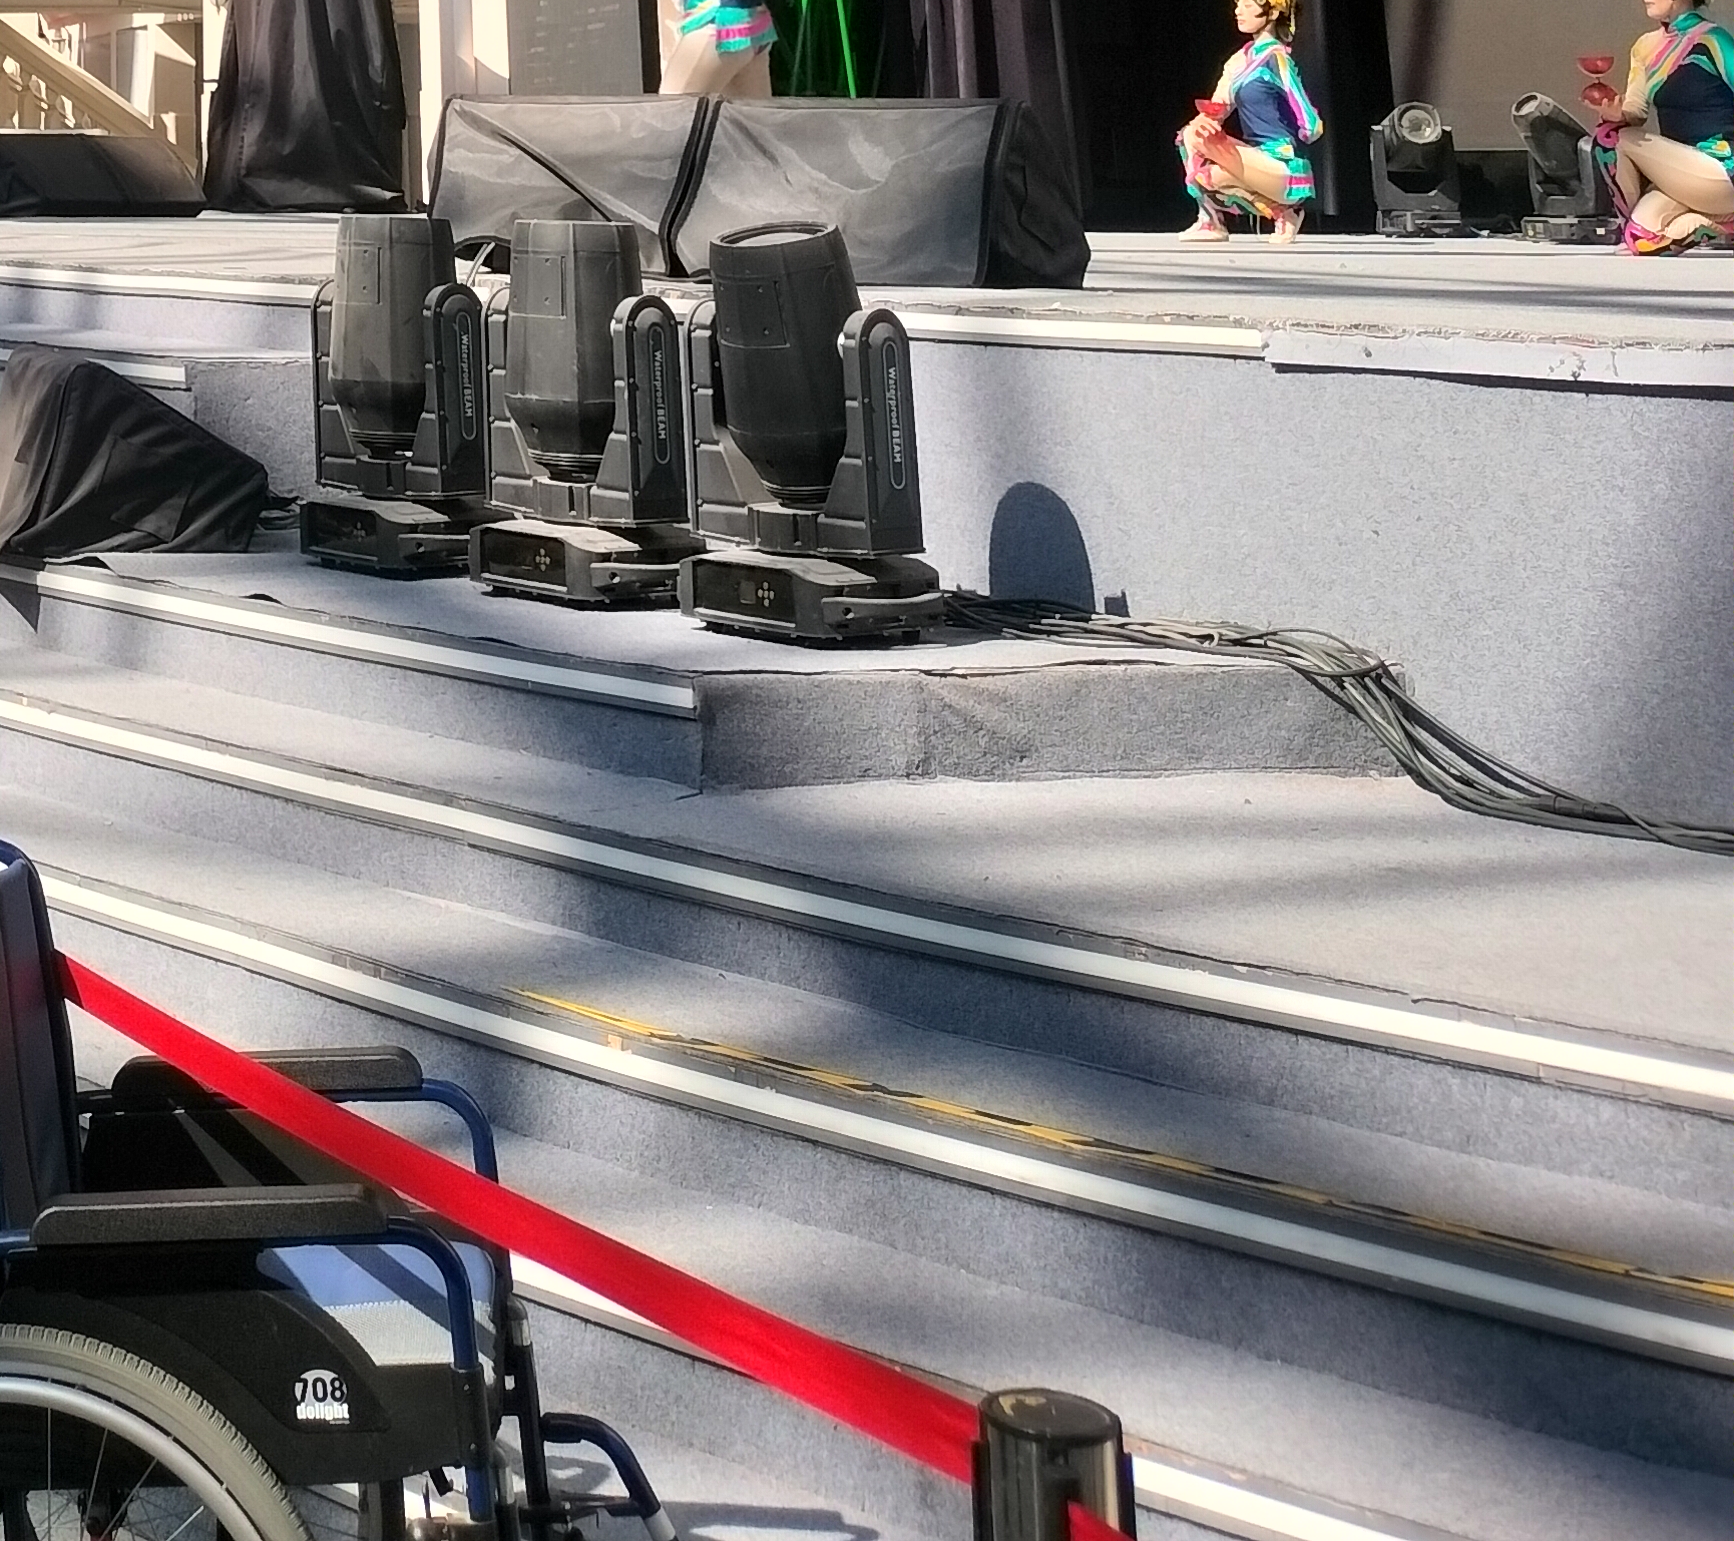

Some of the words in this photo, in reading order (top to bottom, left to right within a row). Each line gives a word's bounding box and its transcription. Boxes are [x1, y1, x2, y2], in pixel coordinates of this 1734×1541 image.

[463, 388, 473, 418] BEAM
[656, 408, 667, 440] BEAM
[891, 430, 903, 464] BEAM
[295, 1377, 346, 1403] 708
[296, 1401, 350, 1421] dolight
